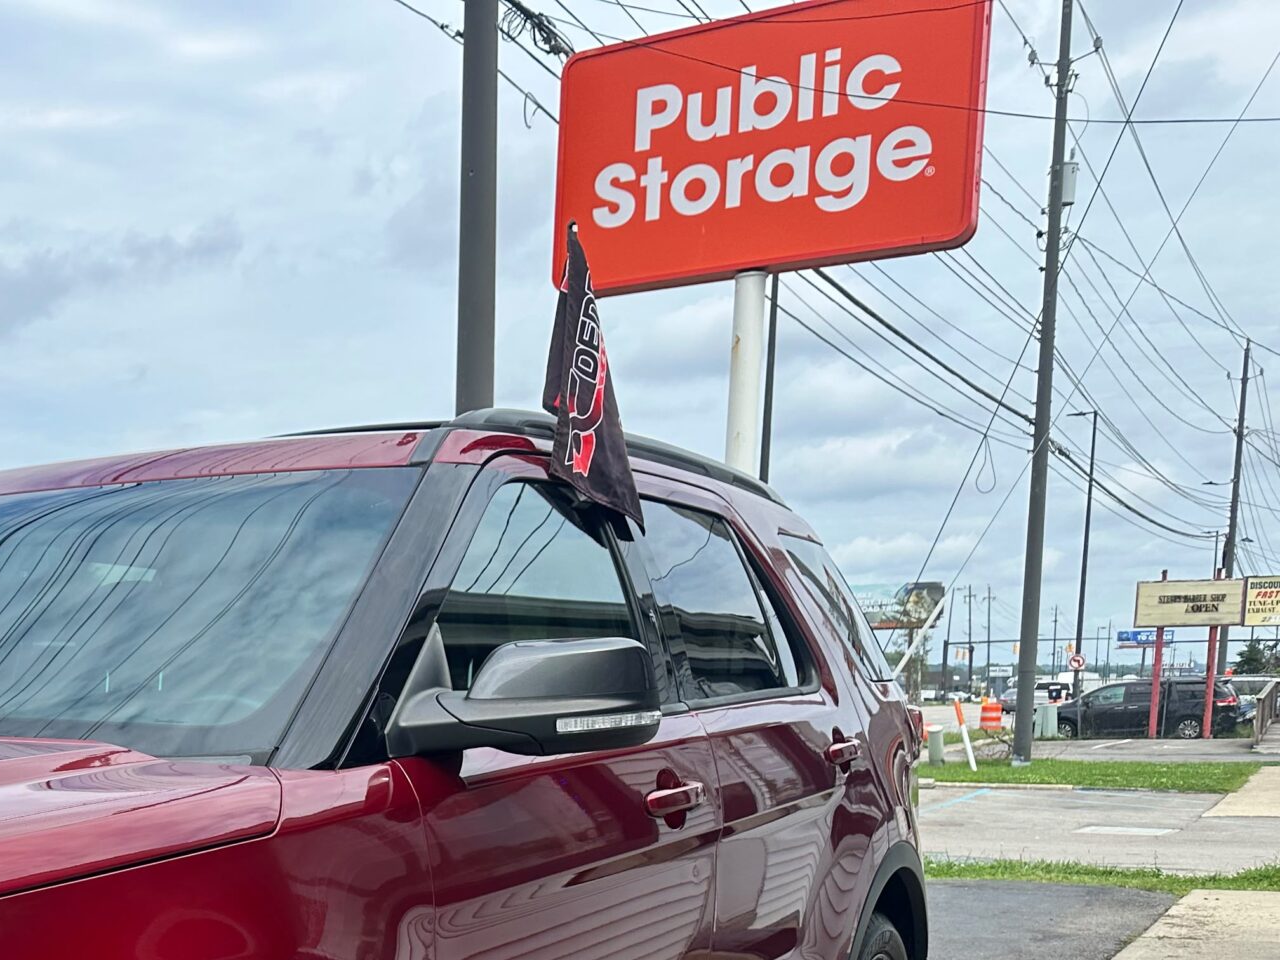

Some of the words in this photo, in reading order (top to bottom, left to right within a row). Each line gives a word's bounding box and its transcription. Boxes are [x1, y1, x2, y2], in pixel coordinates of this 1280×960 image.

[634, 47, 902, 152] Public
[592, 125, 933, 229] Storage
[1191, 603, 1219, 613] OPEN
[1255, 590, 1280, 600] FAST
